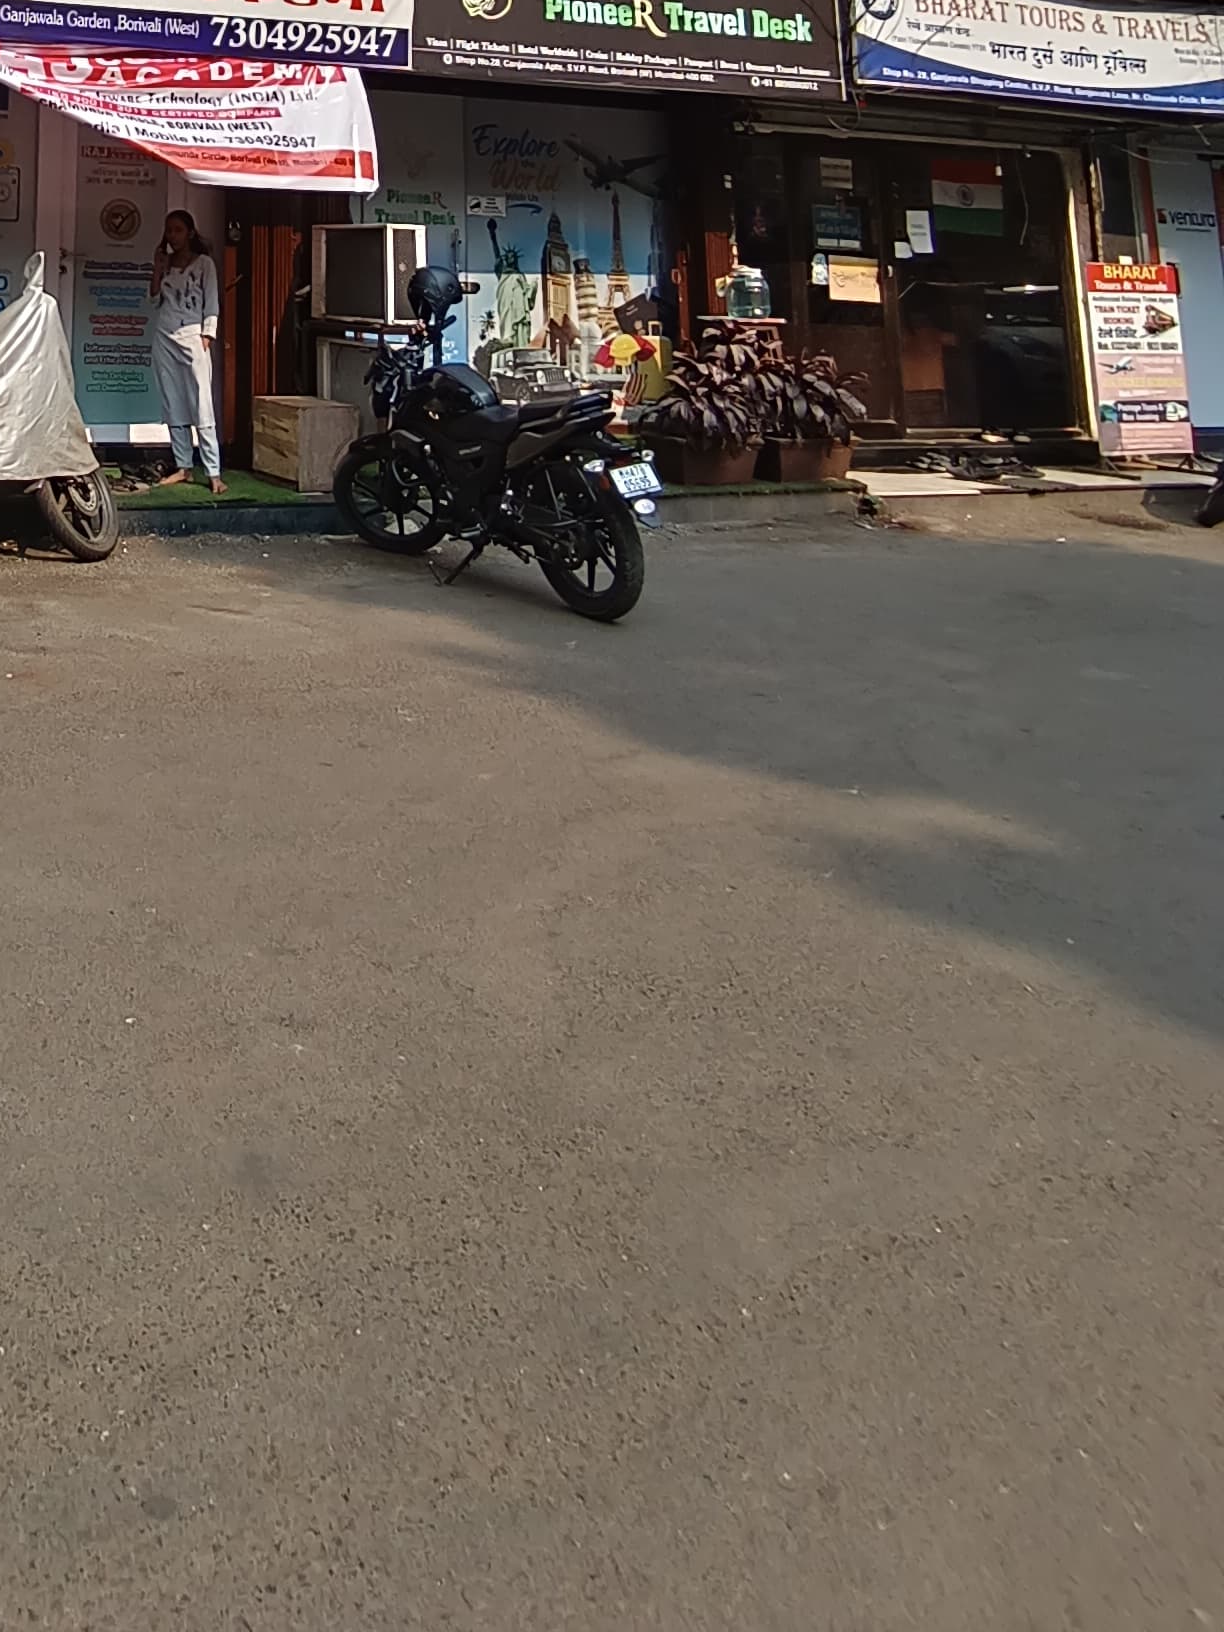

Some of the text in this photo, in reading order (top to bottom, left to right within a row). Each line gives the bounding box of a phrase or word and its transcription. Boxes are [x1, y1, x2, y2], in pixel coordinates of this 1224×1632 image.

[0, 4, 64, 28] Ganjawala
[66, 7, 111, 30] Garden
[164, 19, 200, 38] (West)
[209, 16, 398, 58] 7304925947
[663, 0, 748, 37] Travel
[751, 8, 814, 43] Desk
[1014, 4, 1086, 33] TOURS
[1091, 13, 1108, 35] &
[1112, 15, 1212, 44] TRAVELS
[455, 39, 480, 51] Flight
[988, 40, 1028, 62] भारत
[1059, 46, 1098, 70] आणि
[227, 121, 273, 132] (WEST)
[472, 123, 560, 161] Explore
[488, 157, 561, 193] World
[1103, 265, 1158, 280] BHARAT
